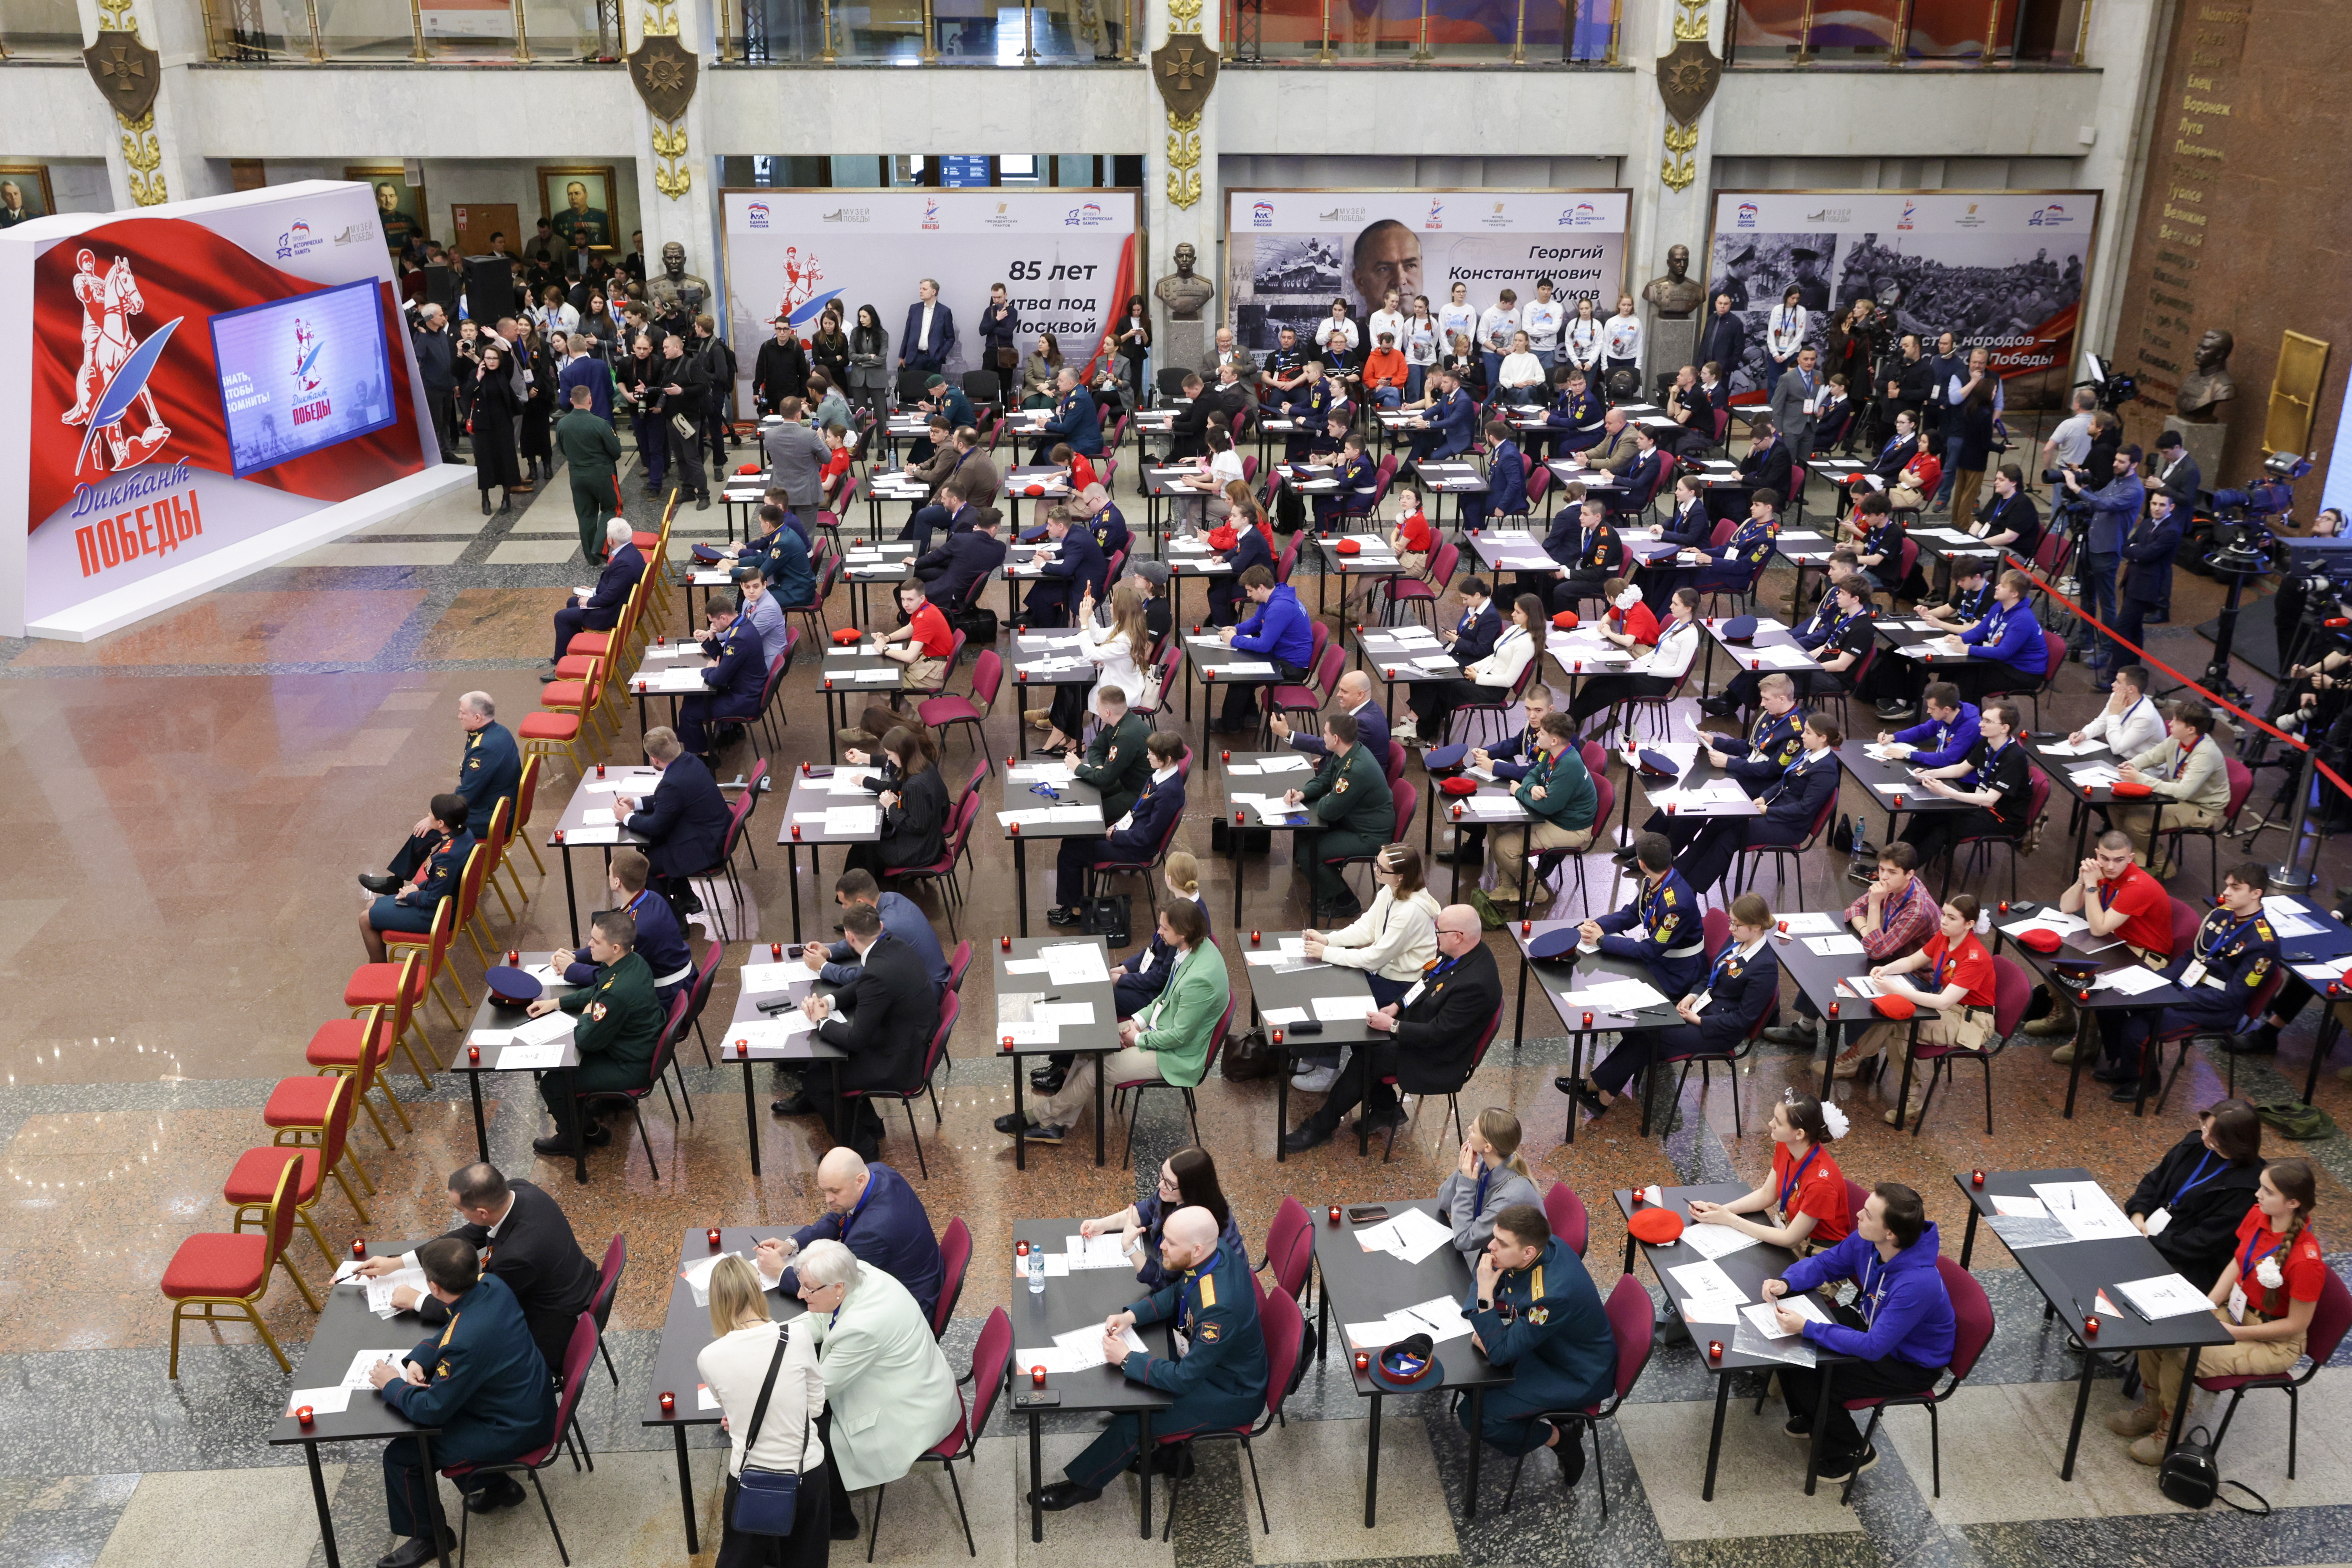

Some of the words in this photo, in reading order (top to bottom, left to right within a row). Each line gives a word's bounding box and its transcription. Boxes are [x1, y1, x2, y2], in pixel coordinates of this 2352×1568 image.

[2183, 95, 2231, 116] Воронеж
[2179, 117, 2204, 136] Луга
[350, 220, 373, 233] МУЗЕЙ
[293, 238, 323, 248] ИСТОРИЧЕСКАЯ
[351, 232, 374, 243] ПОБЕДЫ
[1529, 245, 1604, 262] Георгий
[1009, 261, 1042, 281] 85
[1048, 265, 1098, 280] лет
[1449, 266, 1602, 280] Константинович
[990, 296, 1051, 310] итва
[1058, 299, 1096, 312] под
[1962, 335, 2035, 348] народов
[1990, 352, 2055, 367] Победы
[291, 387, 328, 406] Диктант
[293, 398, 332, 426] ПОБЕДЫ
[71, 455, 190, 518] Диктант
[74, 489, 203, 578] ПОБЕДЫ
